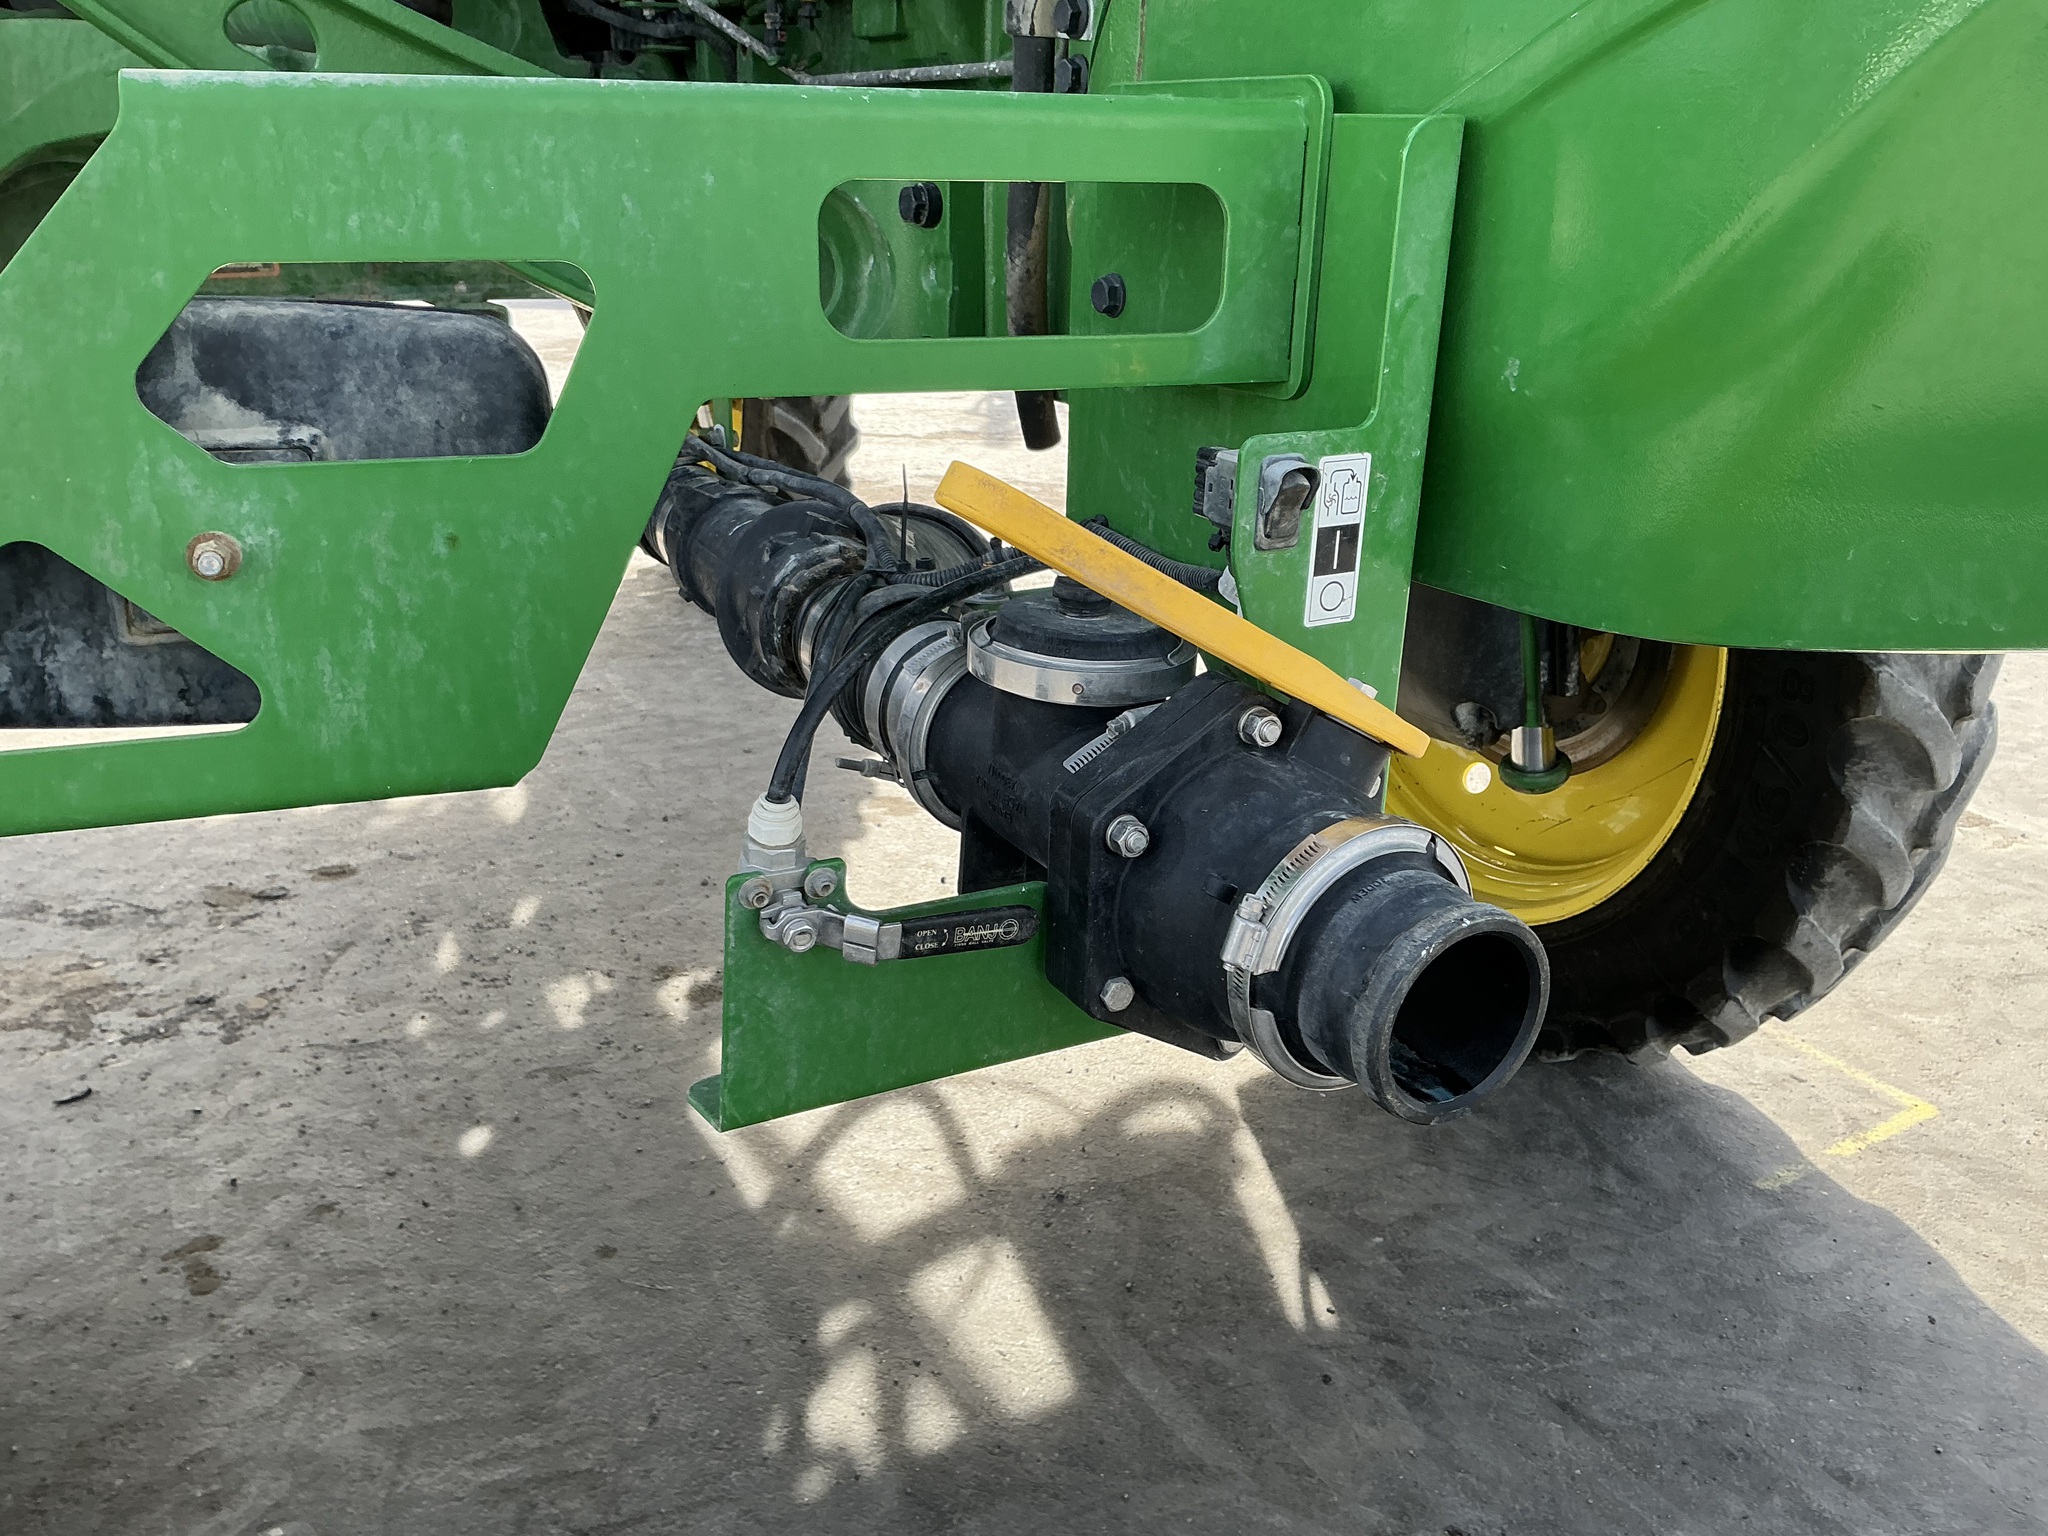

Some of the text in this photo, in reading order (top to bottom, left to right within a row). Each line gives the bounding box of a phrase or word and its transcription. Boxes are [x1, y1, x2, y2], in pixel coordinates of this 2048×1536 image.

[916, 929, 938, 938] OPEN
[953, 918, 1019, 944] BANJO
[914, 942, 940, 951] CLOSE
